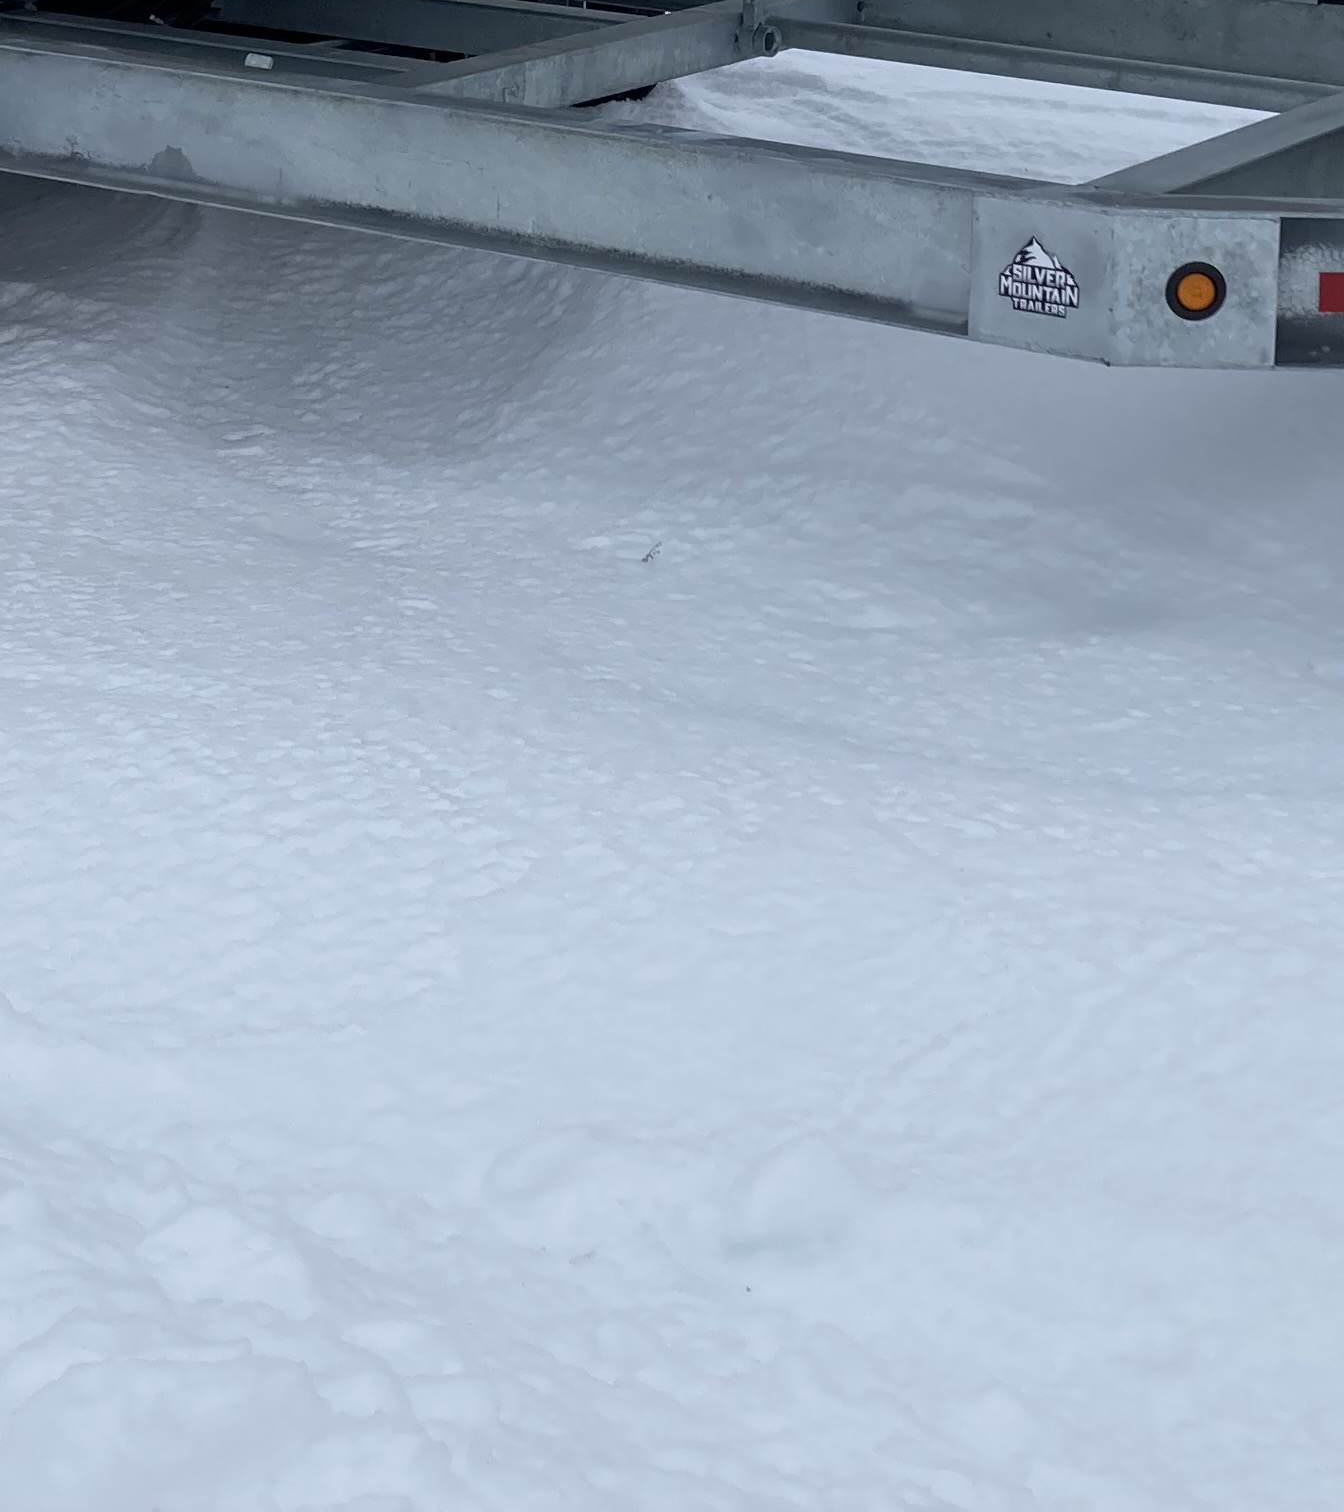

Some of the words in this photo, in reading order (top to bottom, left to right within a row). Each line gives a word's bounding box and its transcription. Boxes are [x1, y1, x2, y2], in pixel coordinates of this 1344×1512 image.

[1013, 264, 1066, 287] SILVER
[1000, 275, 1078, 306] MOUNTAIN
[1013, 298, 1066, 316] TRAILERS
